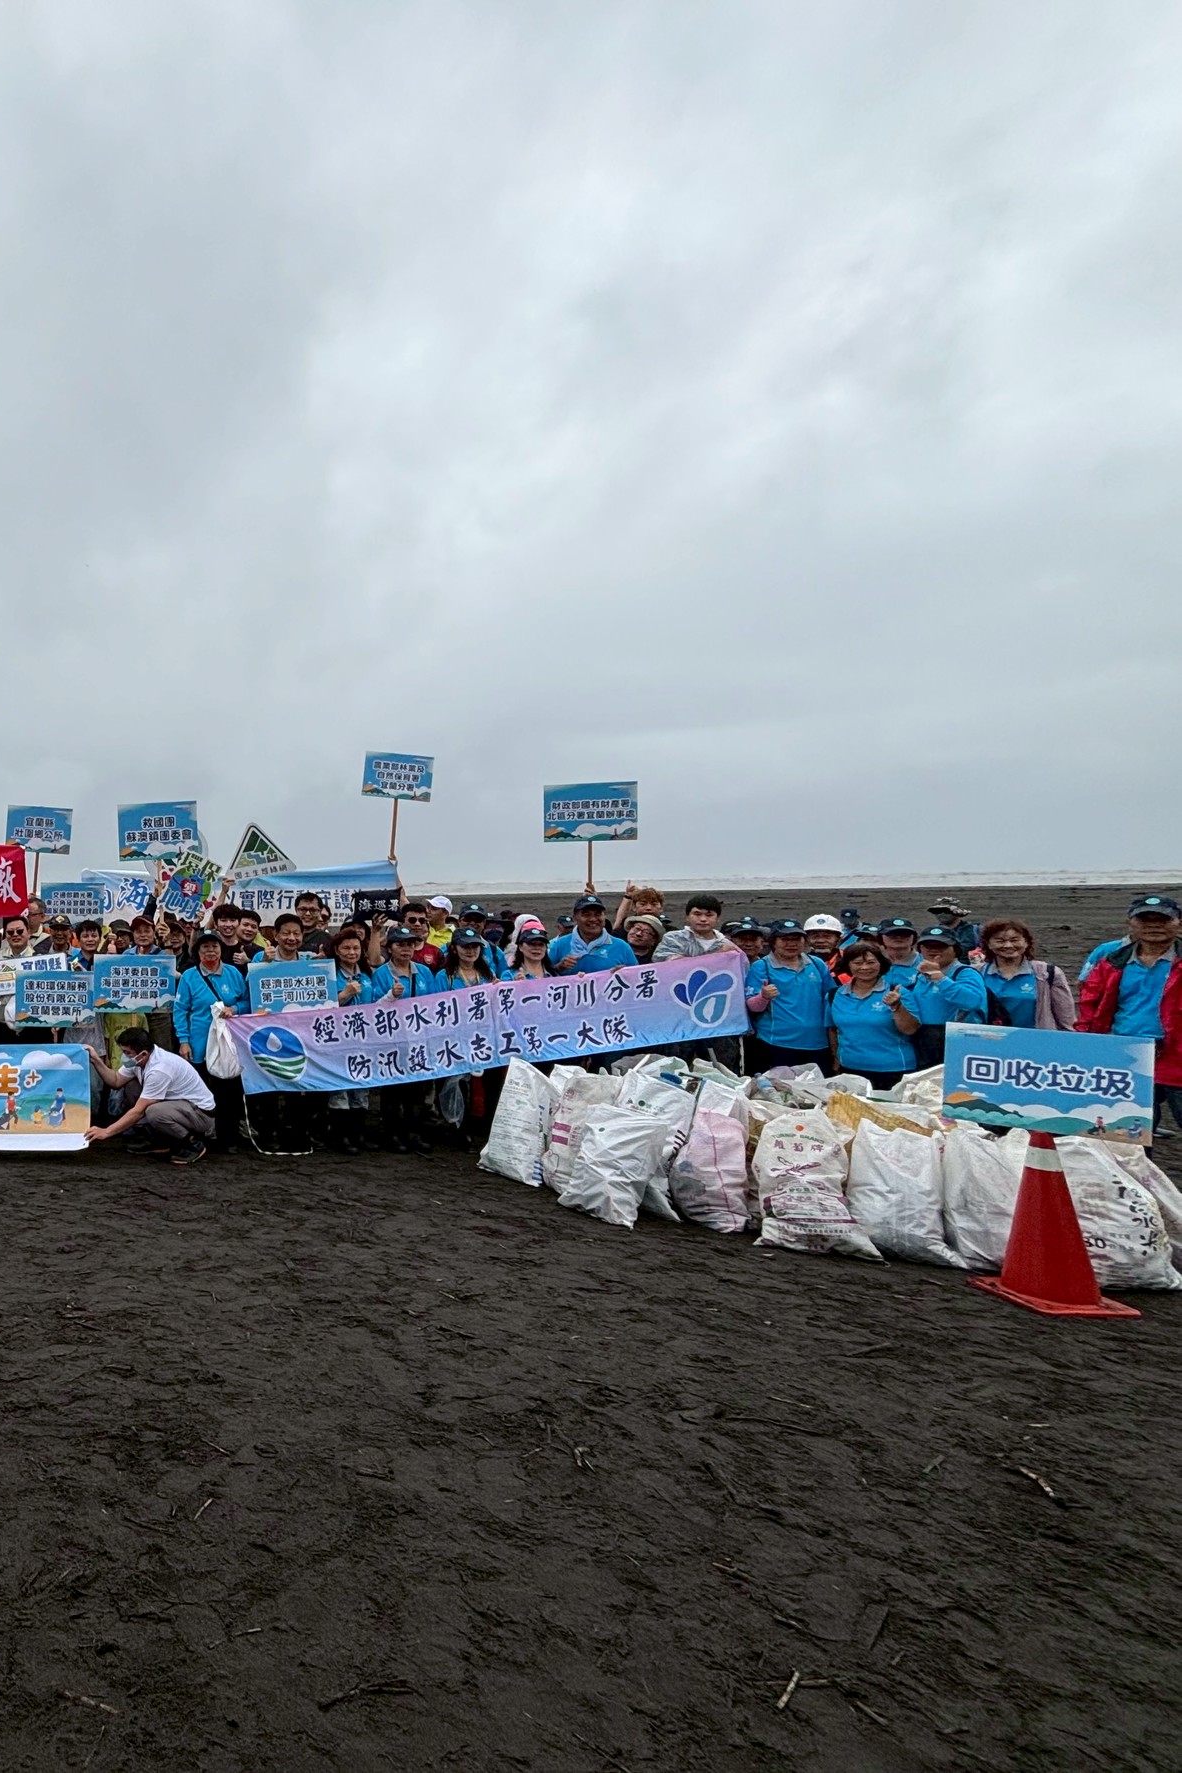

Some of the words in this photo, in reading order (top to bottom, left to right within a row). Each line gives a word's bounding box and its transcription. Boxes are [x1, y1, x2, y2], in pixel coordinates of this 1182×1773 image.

[25, 817, 55, 828] 宜蘭縣
[142, 816, 175, 829] 救國團
[125, 829, 192, 842] 蘇澳鎮團委會
[359, 898, 400, 912] 海巡署
[21, 957, 63, 971] 宜蘭縣
[110, 966, 160, 977] 海洋委員會
[25, 979, 88, 992] 達和環保服務
[102, 978, 168, 990] 海巡署北部分署
[260, 975, 327, 990] 經濟部水利署
[25, 993, 88, 1005] 股份有限公司
[111, 989, 160, 1000] 第一岸巡隊
[261, 989, 328, 1003] 第一河川分署
[30, 1006, 82, 1017] 宜蘭營業所
[312, 970, 658, 1043] 經濟部水利署第一河川分署
[965, 1055, 1132, 1099] 回收垃圾
